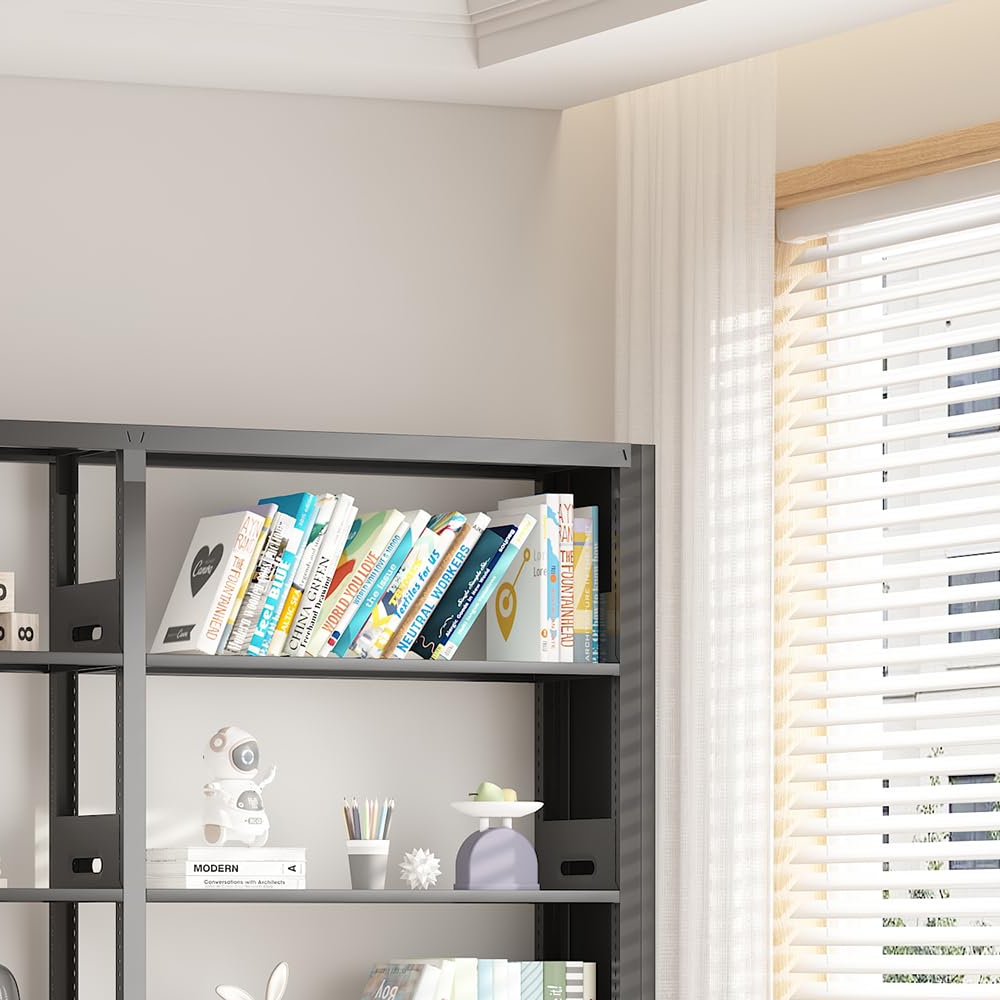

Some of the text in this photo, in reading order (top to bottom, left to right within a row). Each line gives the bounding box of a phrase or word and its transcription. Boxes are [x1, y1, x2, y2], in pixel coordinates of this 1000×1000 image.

[206, 568, 241, 640] FOUNTAINHEAD
[259, 560, 290, 638] Feel BLUE
[289, 556, 330, 650] CHINA GREEN
[300, 576, 332, 648] Freehand Drawing
[322, 550, 379, 633] WORLD YOU LOVE
[365, 564, 396, 608] the issue
[394, 549, 440, 618] Textiles for US
[397, 544, 470, 652] NEUTRAL WORKERS
[561, 565, 574, 647] FOUNTAINHEAD
[18, 626, 34, 642] 8
[194, 864, 238, 873] MODERN
[546, 985, 562, 996] it!
